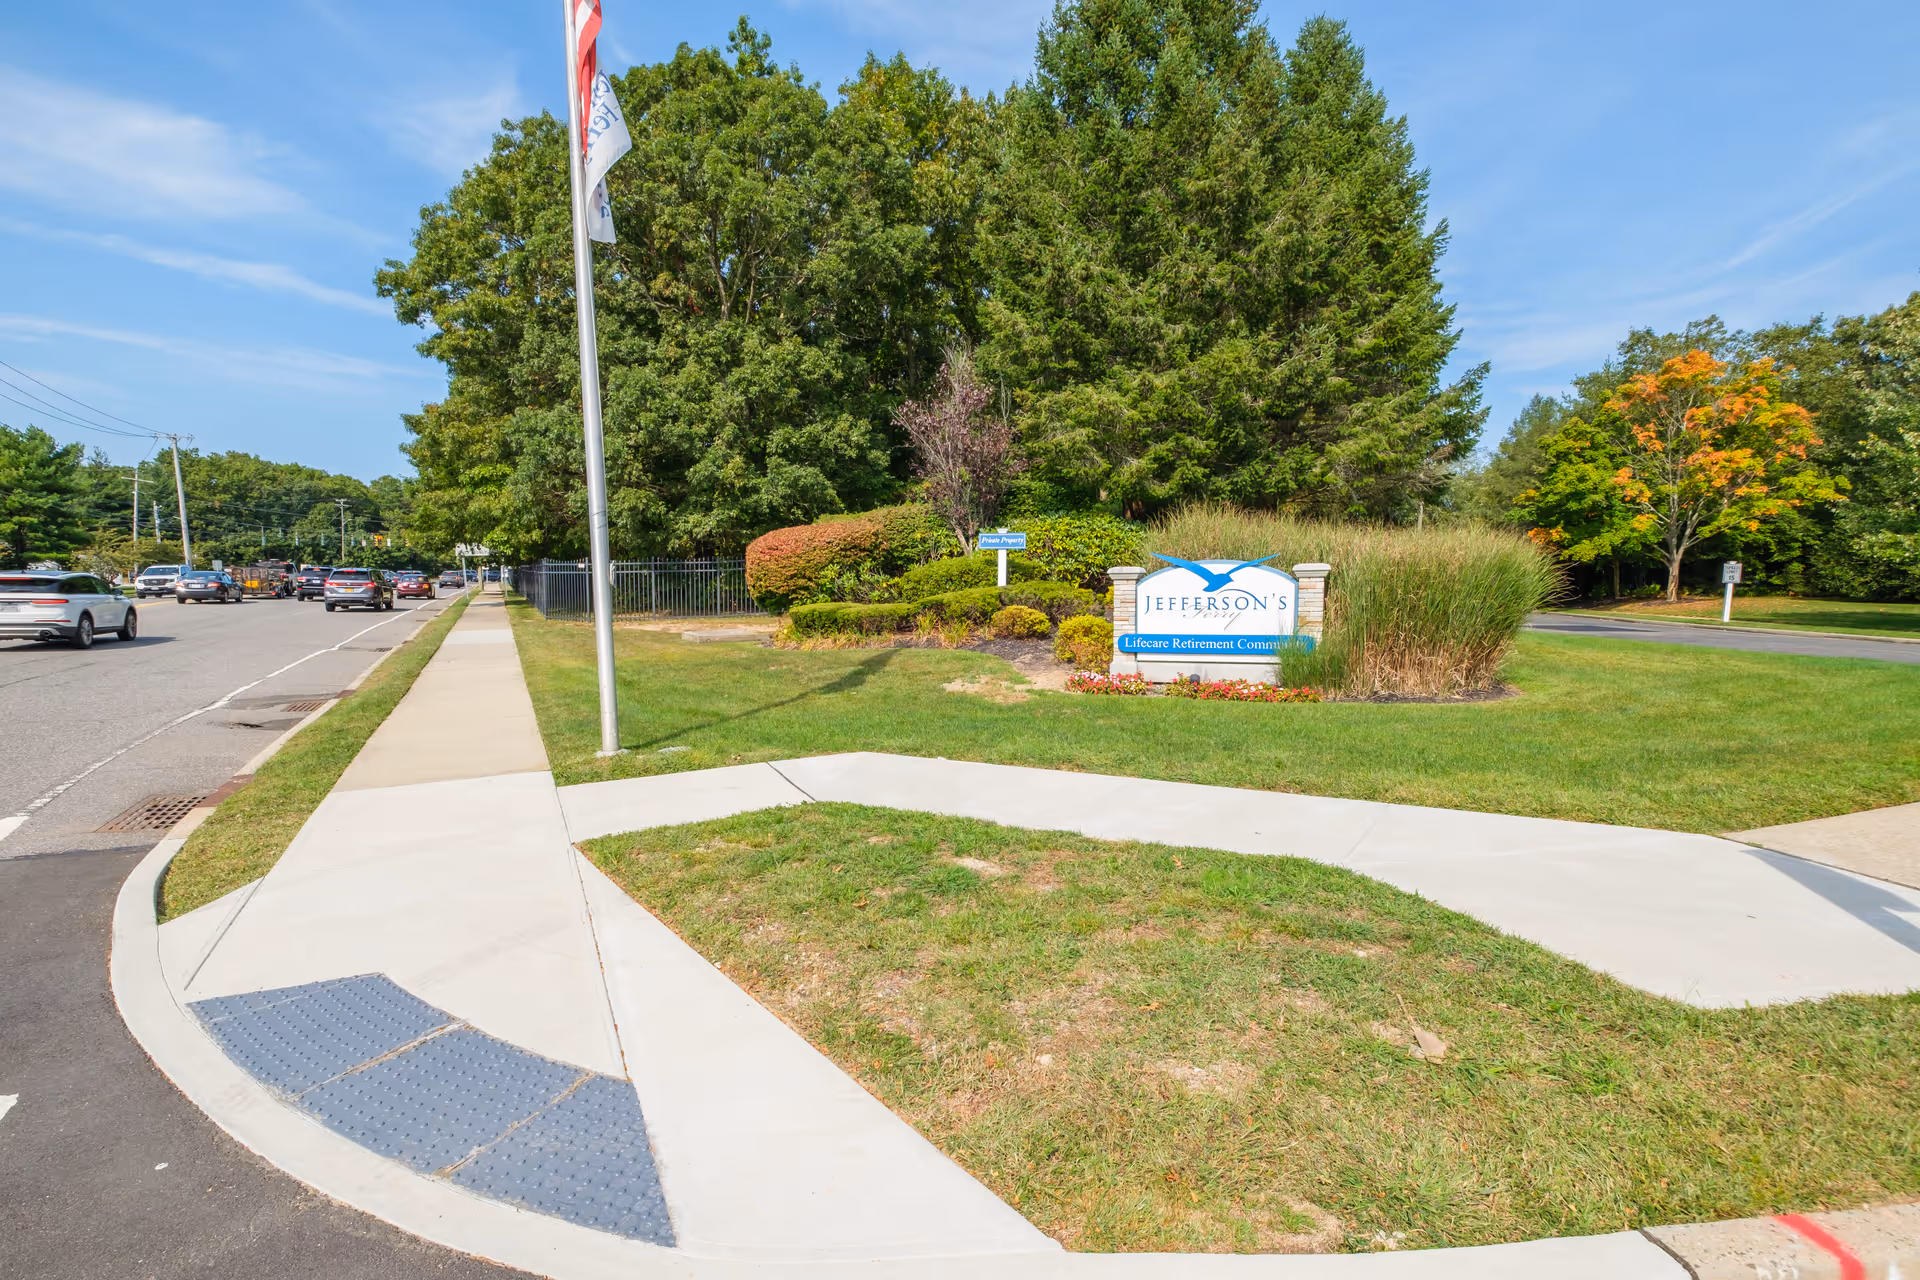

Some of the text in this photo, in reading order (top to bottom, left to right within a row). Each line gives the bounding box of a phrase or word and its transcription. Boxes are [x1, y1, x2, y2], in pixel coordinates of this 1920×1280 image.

[982, 536, 1024, 546] Private Property
[1144, 591, 1287, 614] JEFFERSON'S
[1124, 637, 1170, 648] Lifecare
[1172, 637, 1234, 649] Retirement
